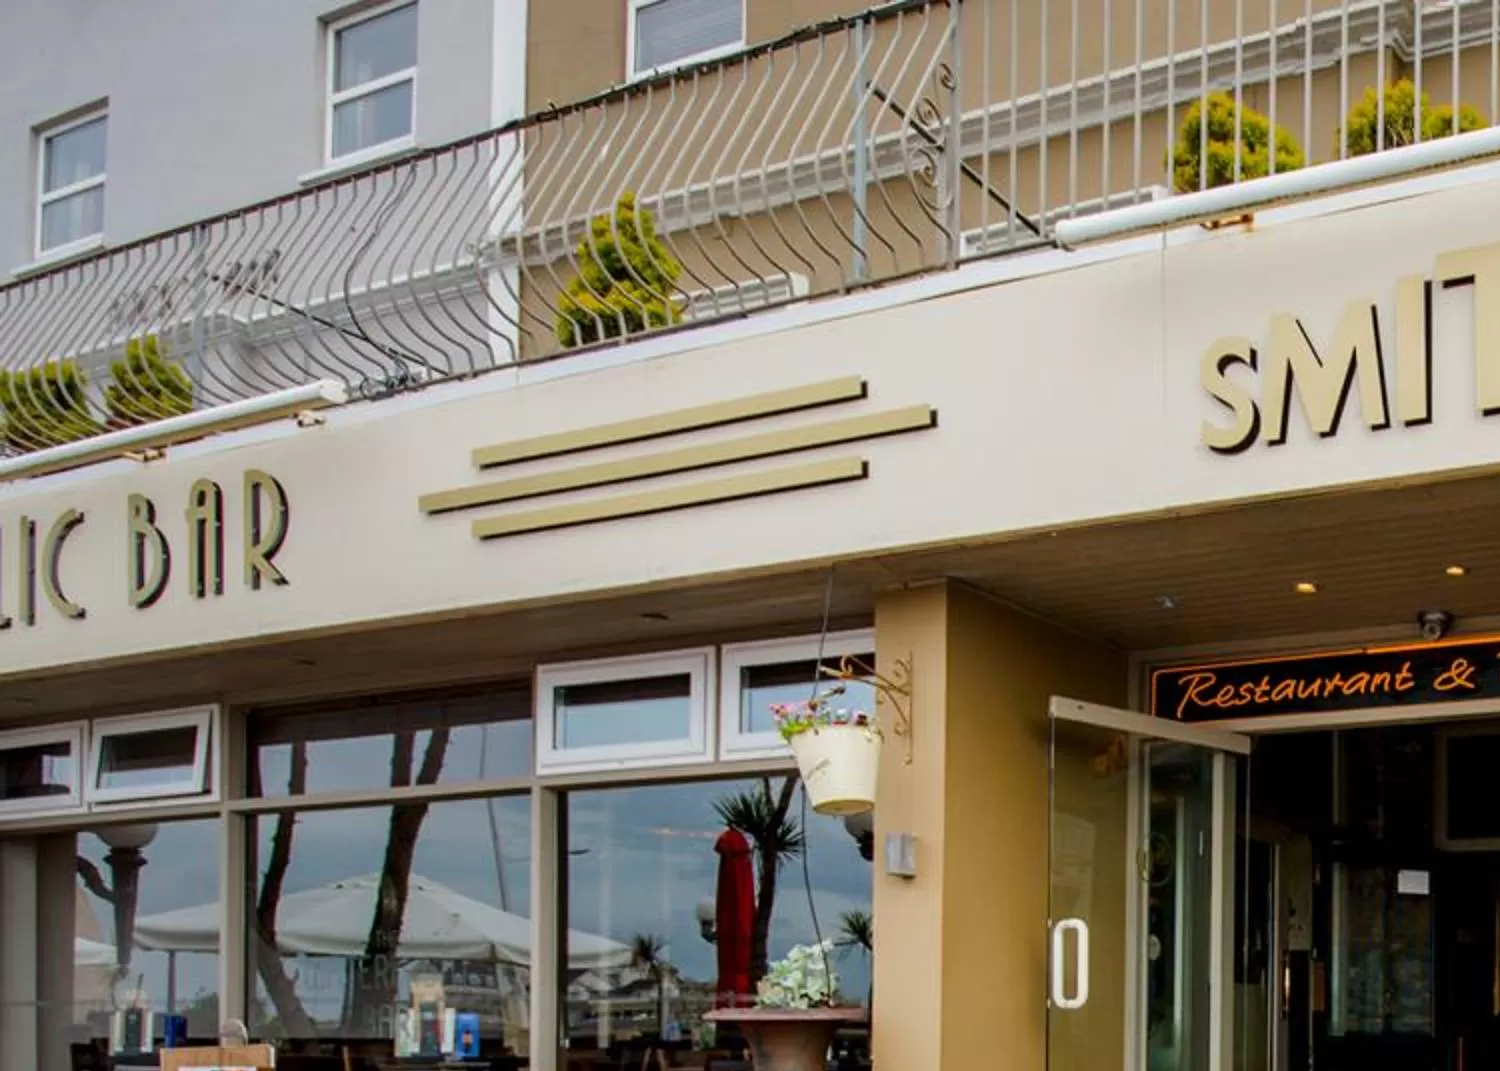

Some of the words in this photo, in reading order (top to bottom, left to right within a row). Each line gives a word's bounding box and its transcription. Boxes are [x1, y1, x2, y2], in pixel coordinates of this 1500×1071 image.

[128, 469, 289, 609] BAR
[1176, 661, 1415, 719] Restaurant
[1433, 657, 1476, 691] &
